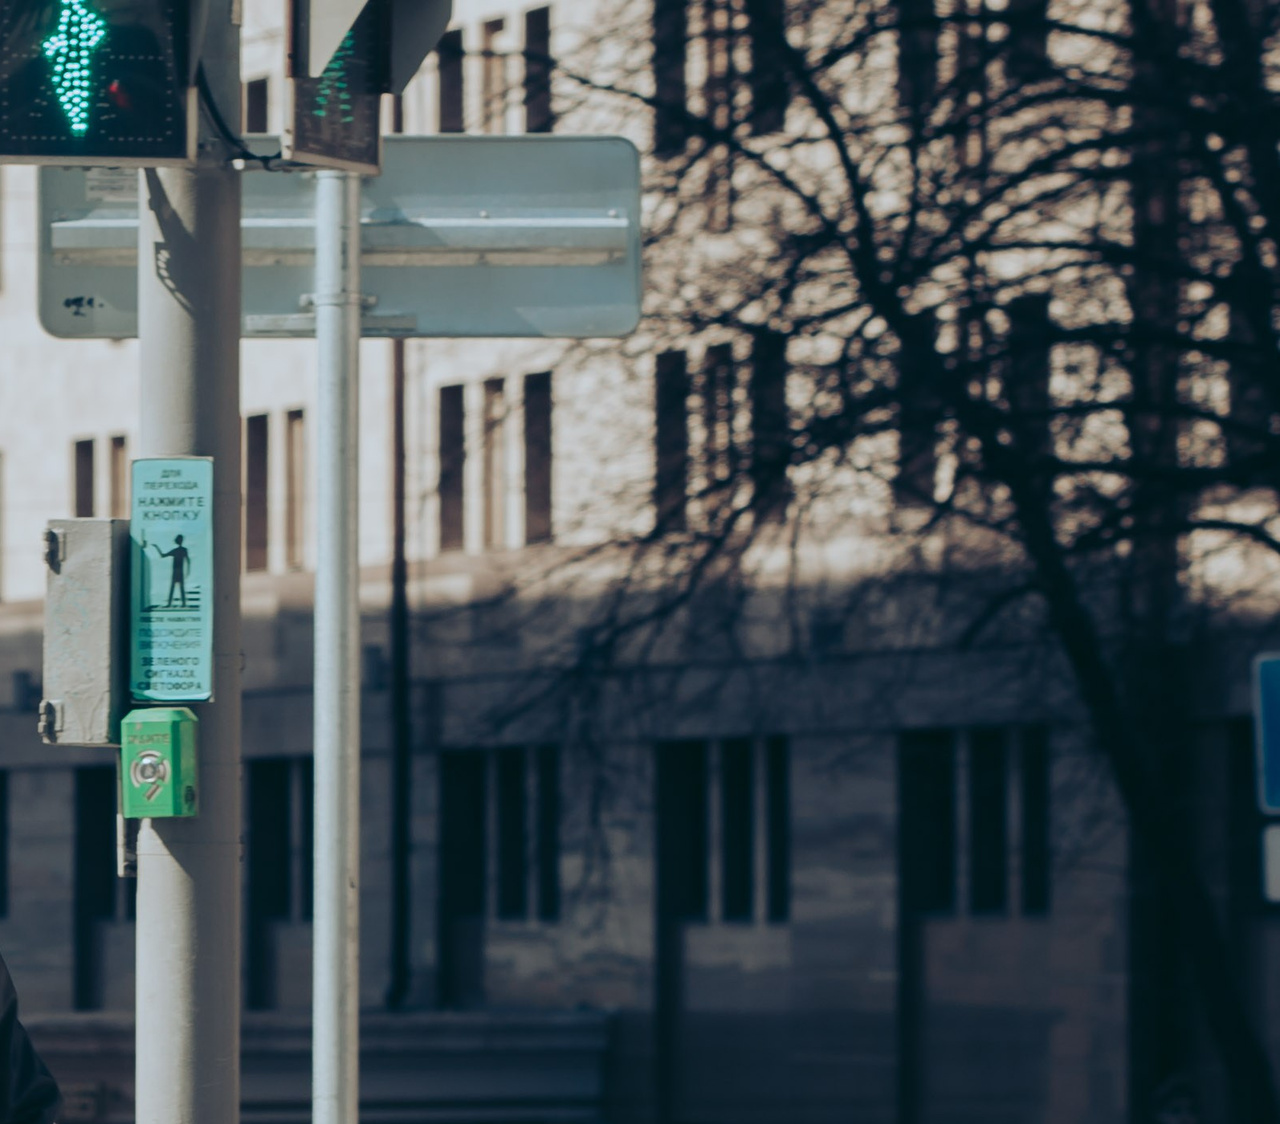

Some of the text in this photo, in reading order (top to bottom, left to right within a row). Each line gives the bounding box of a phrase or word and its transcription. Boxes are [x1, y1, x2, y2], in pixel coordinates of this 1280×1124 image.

[161, 468, 182, 478] ДЛЯ
[143, 481, 199, 490] ПЕРЕХОДА
[137, 496, 206, 507] НАЖМИТЕ
[142, 509, 201, 521] КНОПКУ
[141, 656, 200, 667] ЗЕЛЕНОГО
[144, 669, 196, 679] СИГНАЛА
[136, 681, 202, 691] СВЕТОФОРА
